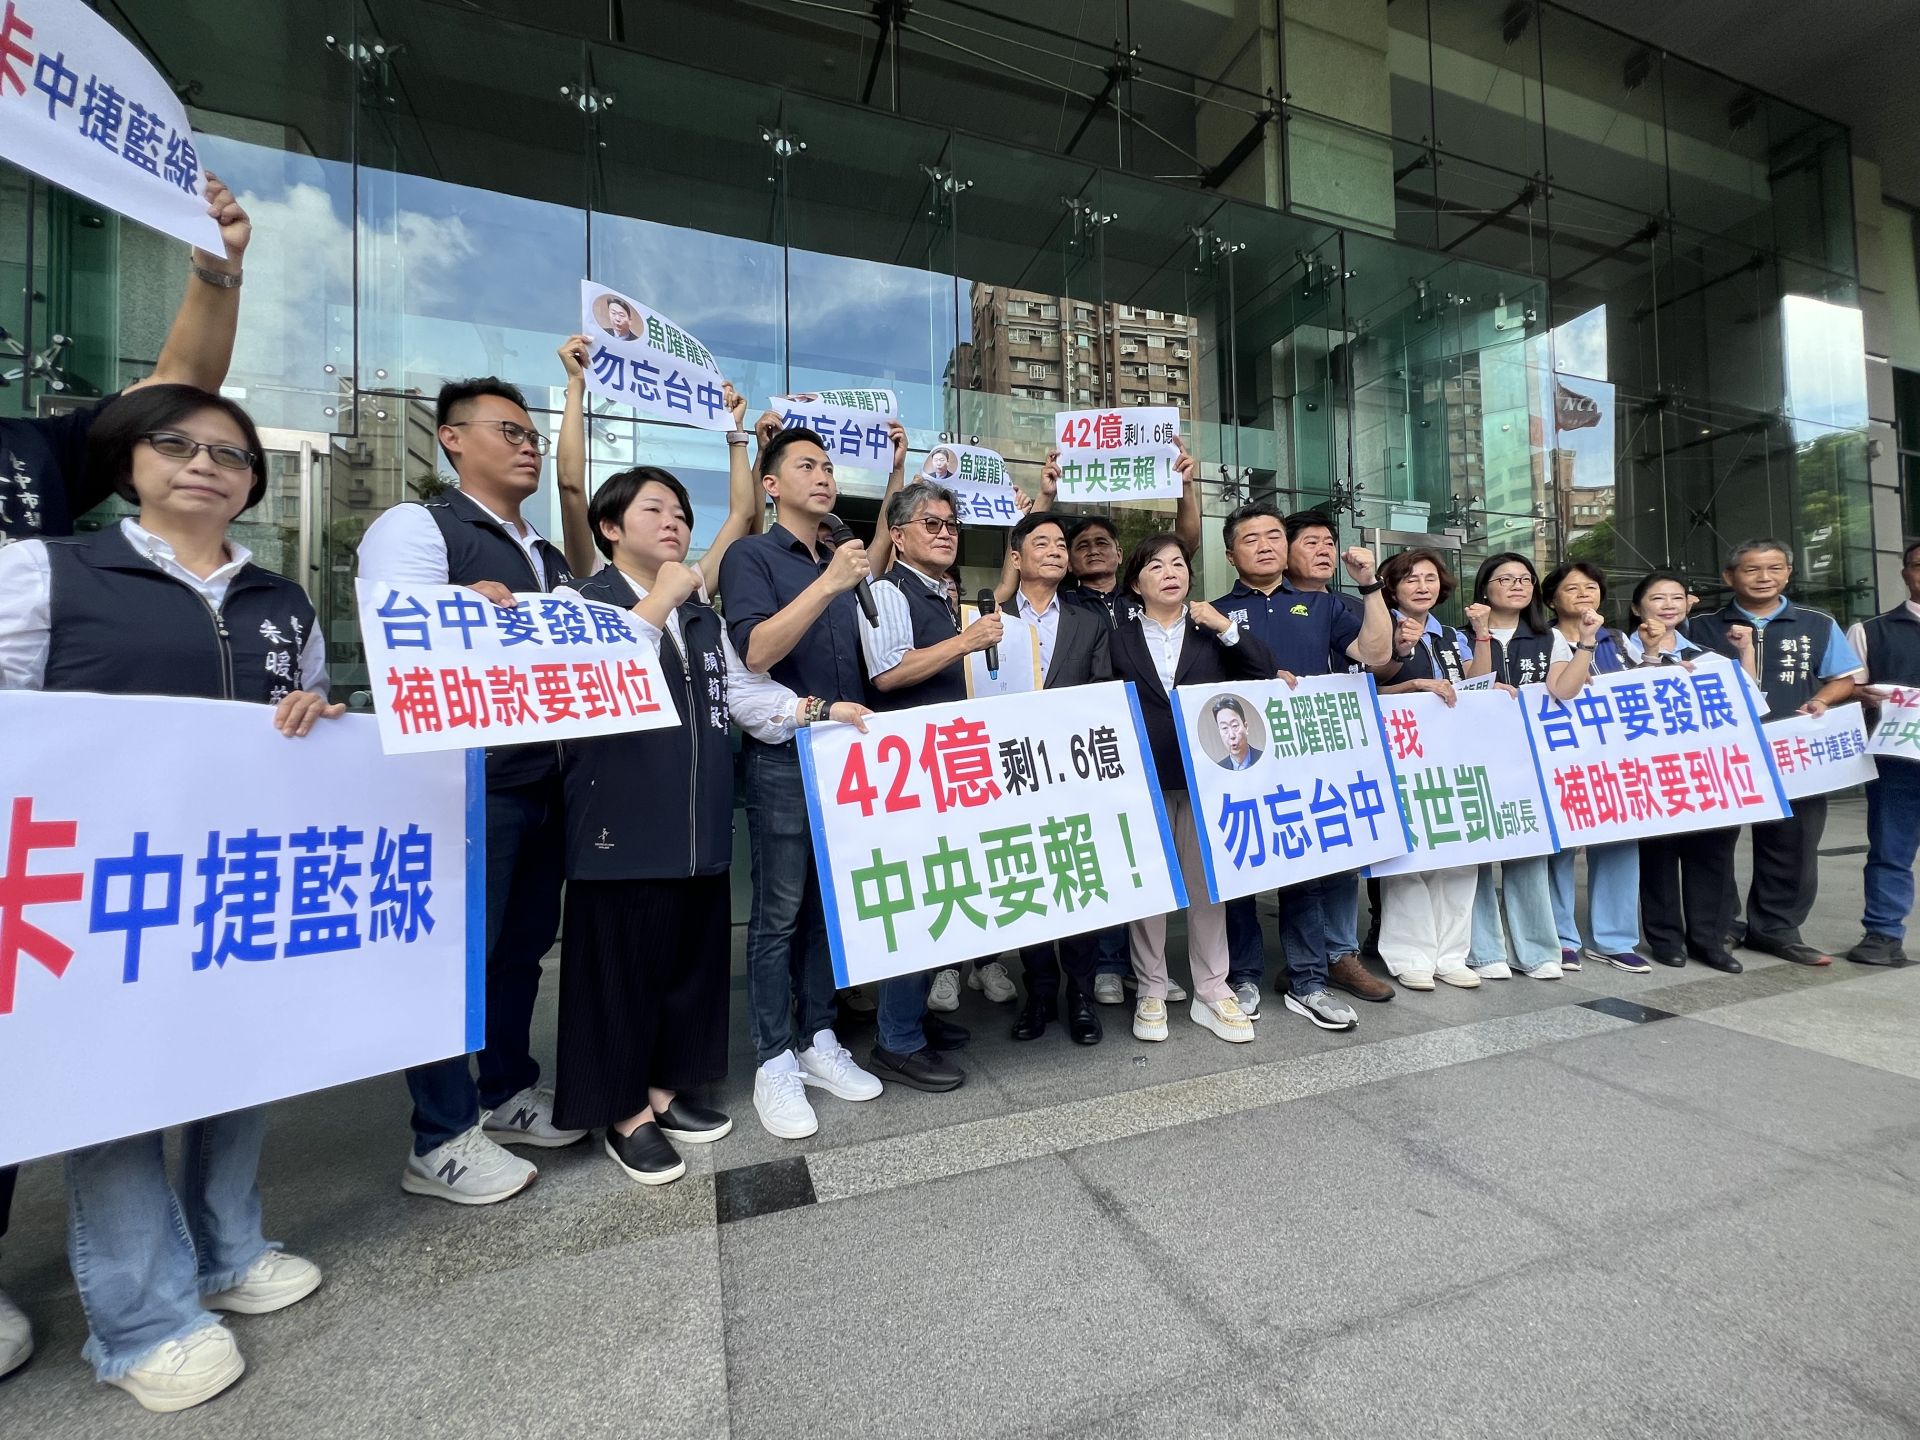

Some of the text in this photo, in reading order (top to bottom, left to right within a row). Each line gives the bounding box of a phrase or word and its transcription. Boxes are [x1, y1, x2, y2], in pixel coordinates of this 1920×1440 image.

[646, 315, 719, 374] 魚躍龍門
[592, 345, 724, 420] 勿忘台中
[377, 589, 638, 650] 台中要發展
[1228, 608, 1250, 630] 顏
[386, 659, 661, 735] 補助款要到位
[1780, 639, 1798, 685] 劉士州
[1265, 691, 1369, 760] 魚躍龍門
[1383, 709, 1424, 760] 找
[1537, 672, 1738, 752] 台中要發展
[1554, 743, 1765, 832] 補助款要到位
[1767, 728, 1866, 776] 再卡中捷藍線
[1218, 770, 1386, 871] 勿忘台中
[0, 797, 436, 1015] 卡中捷藍線
[851, 812, 1143, 953] 中央耍賴！
